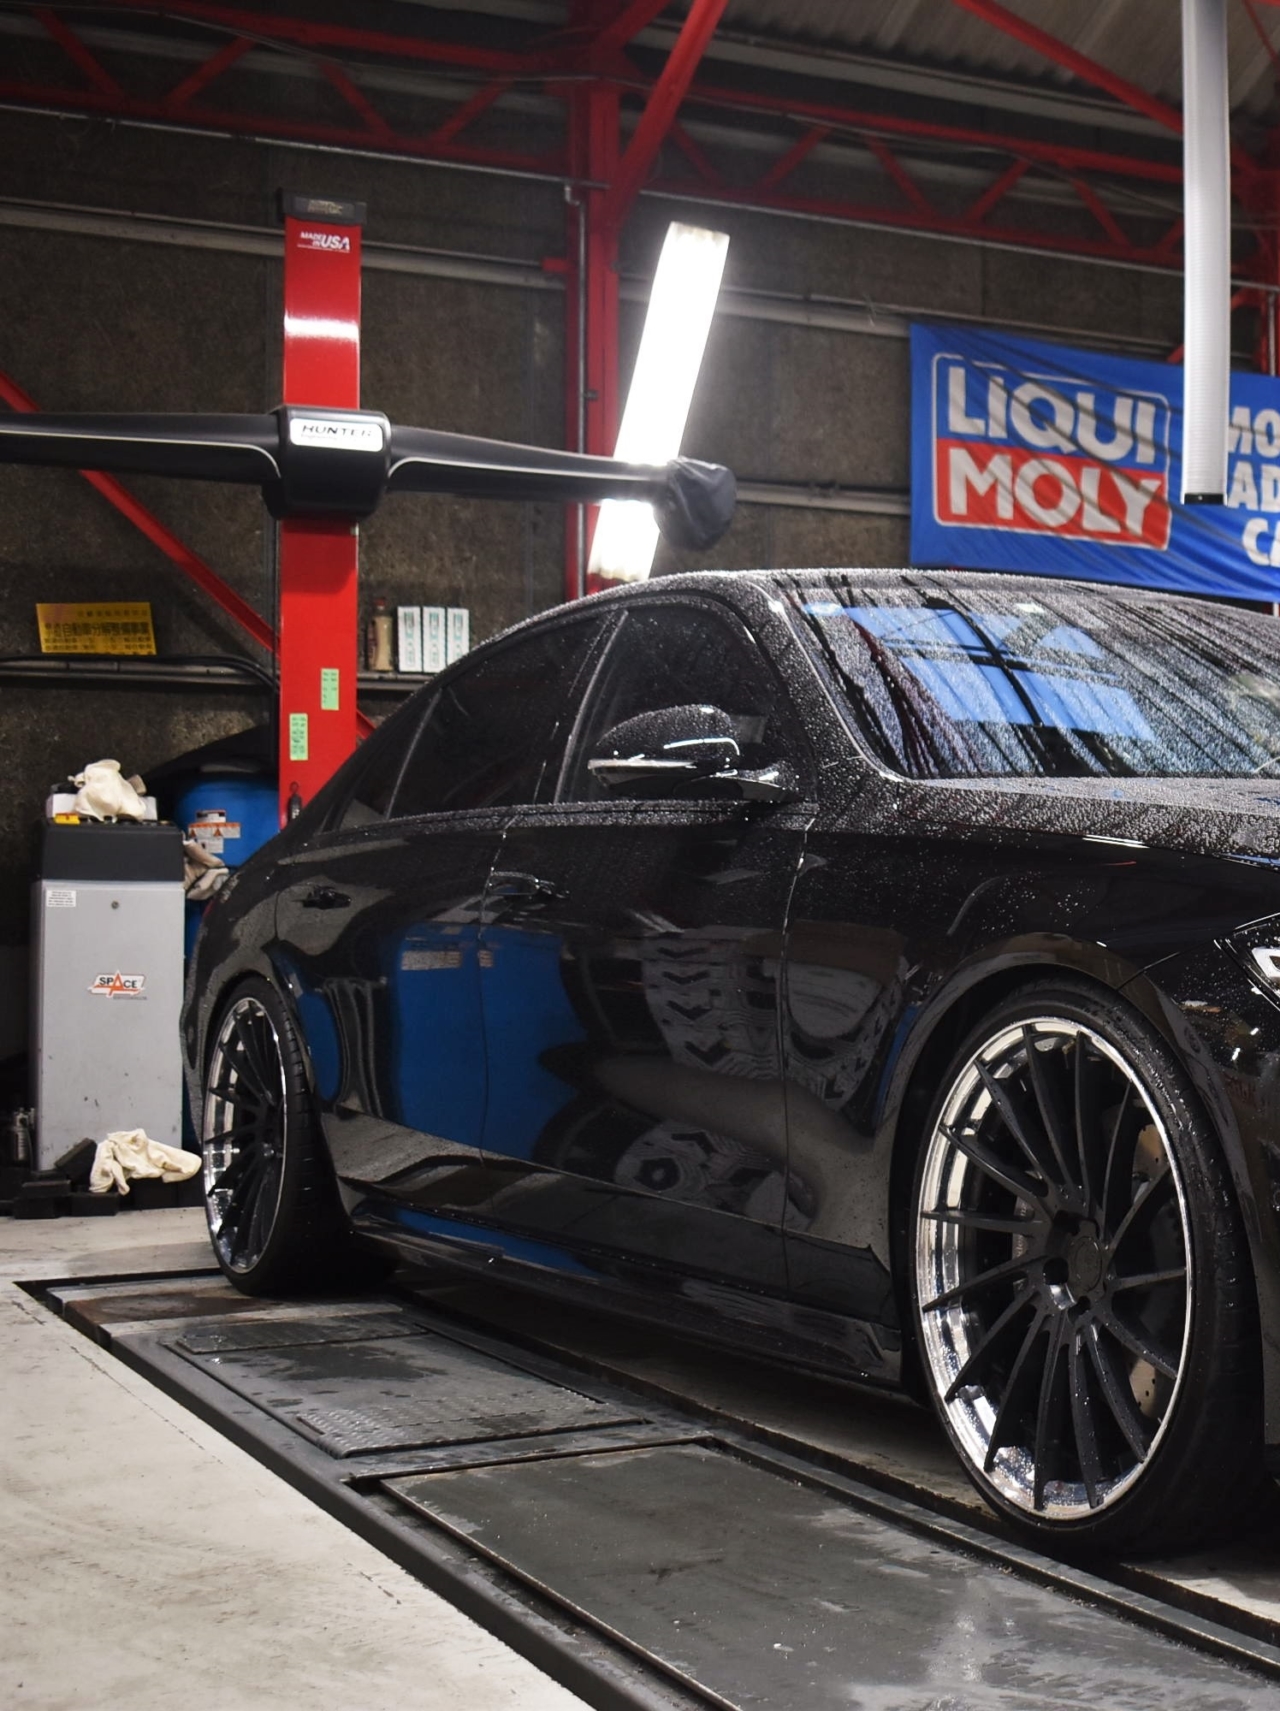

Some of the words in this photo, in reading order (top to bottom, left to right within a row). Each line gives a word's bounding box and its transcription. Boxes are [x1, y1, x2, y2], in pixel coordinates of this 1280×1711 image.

[321, 234, 350, 251] USA
[948, 366, 1156, 464] LIQUI
[949, 447, 1162, 537] MOLY
[99, 973, 138, 989] SPACE
